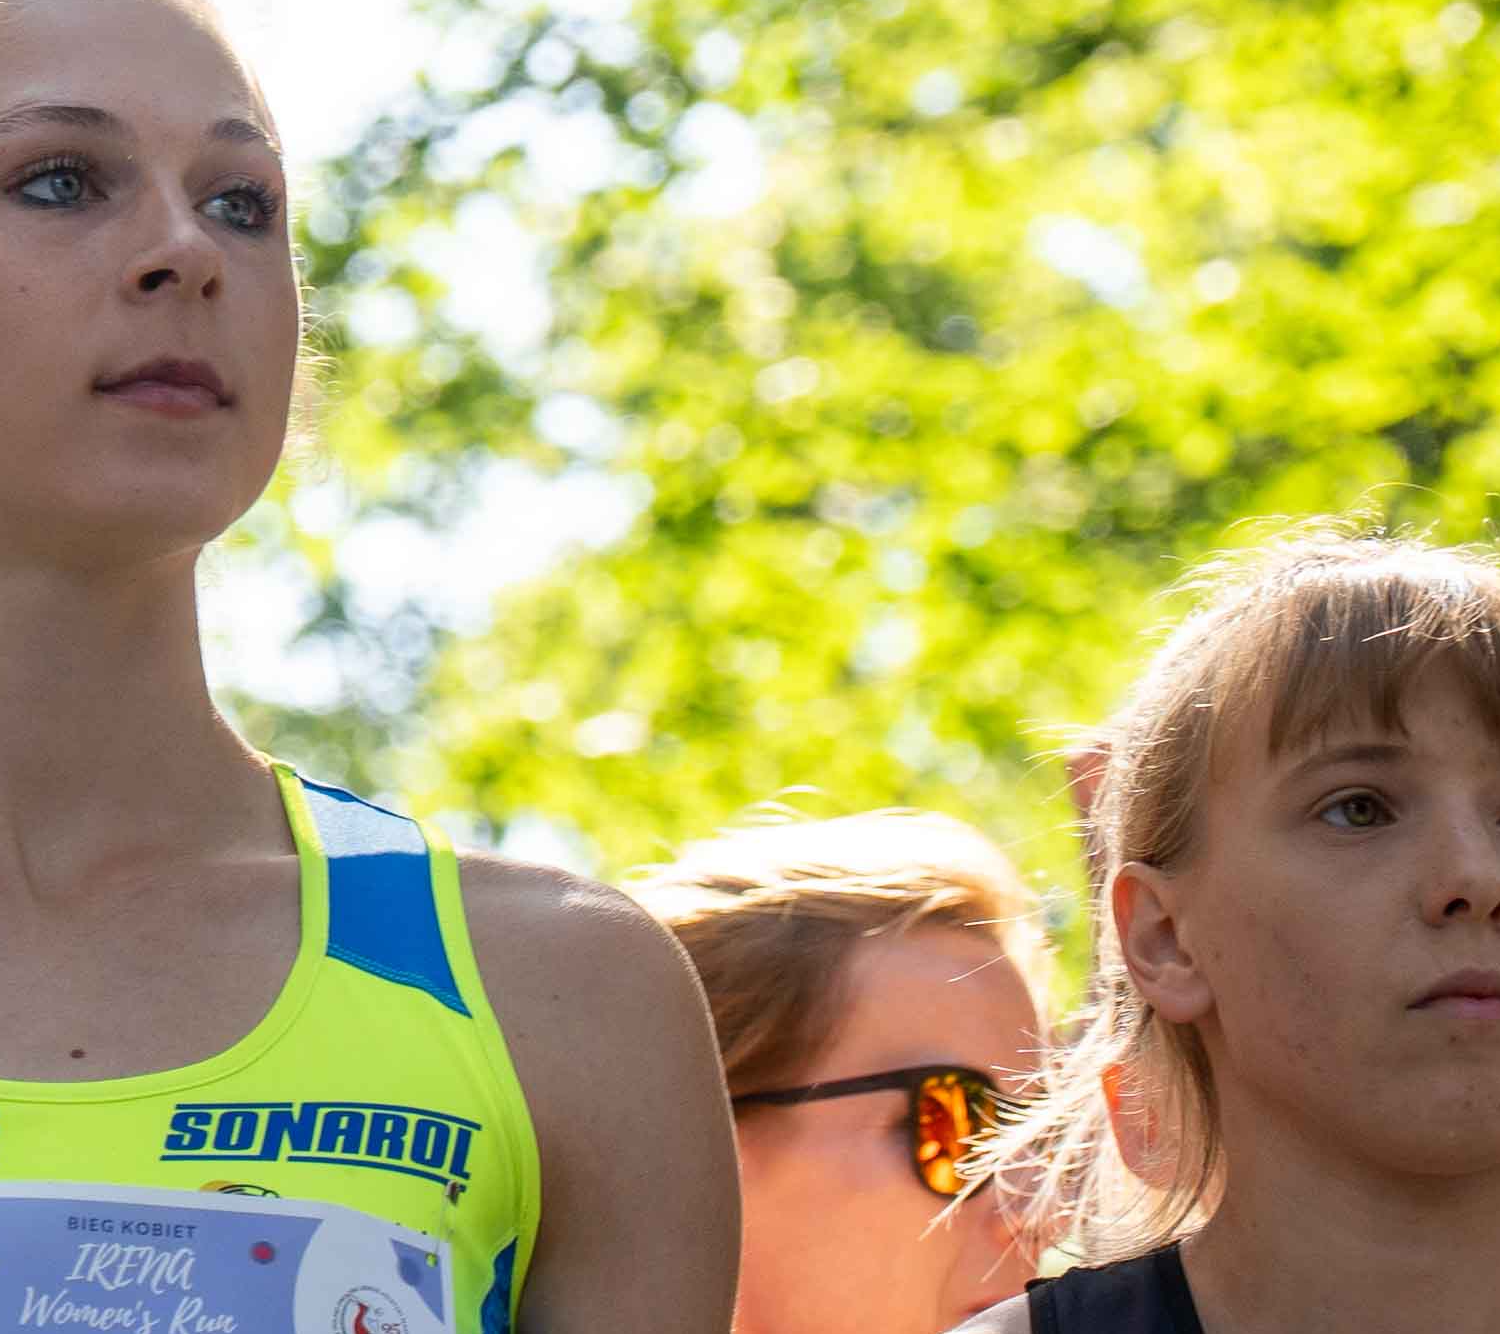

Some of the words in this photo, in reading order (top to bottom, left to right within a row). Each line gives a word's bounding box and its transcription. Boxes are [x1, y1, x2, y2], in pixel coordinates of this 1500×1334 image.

[162, 1103, 476, 1183] SONAROL
[67, 1216, 113, 1233] BIEG
[121, 1220, 197, 1238] KOBIET
[64, 1242, 196, 1295] IRENA
